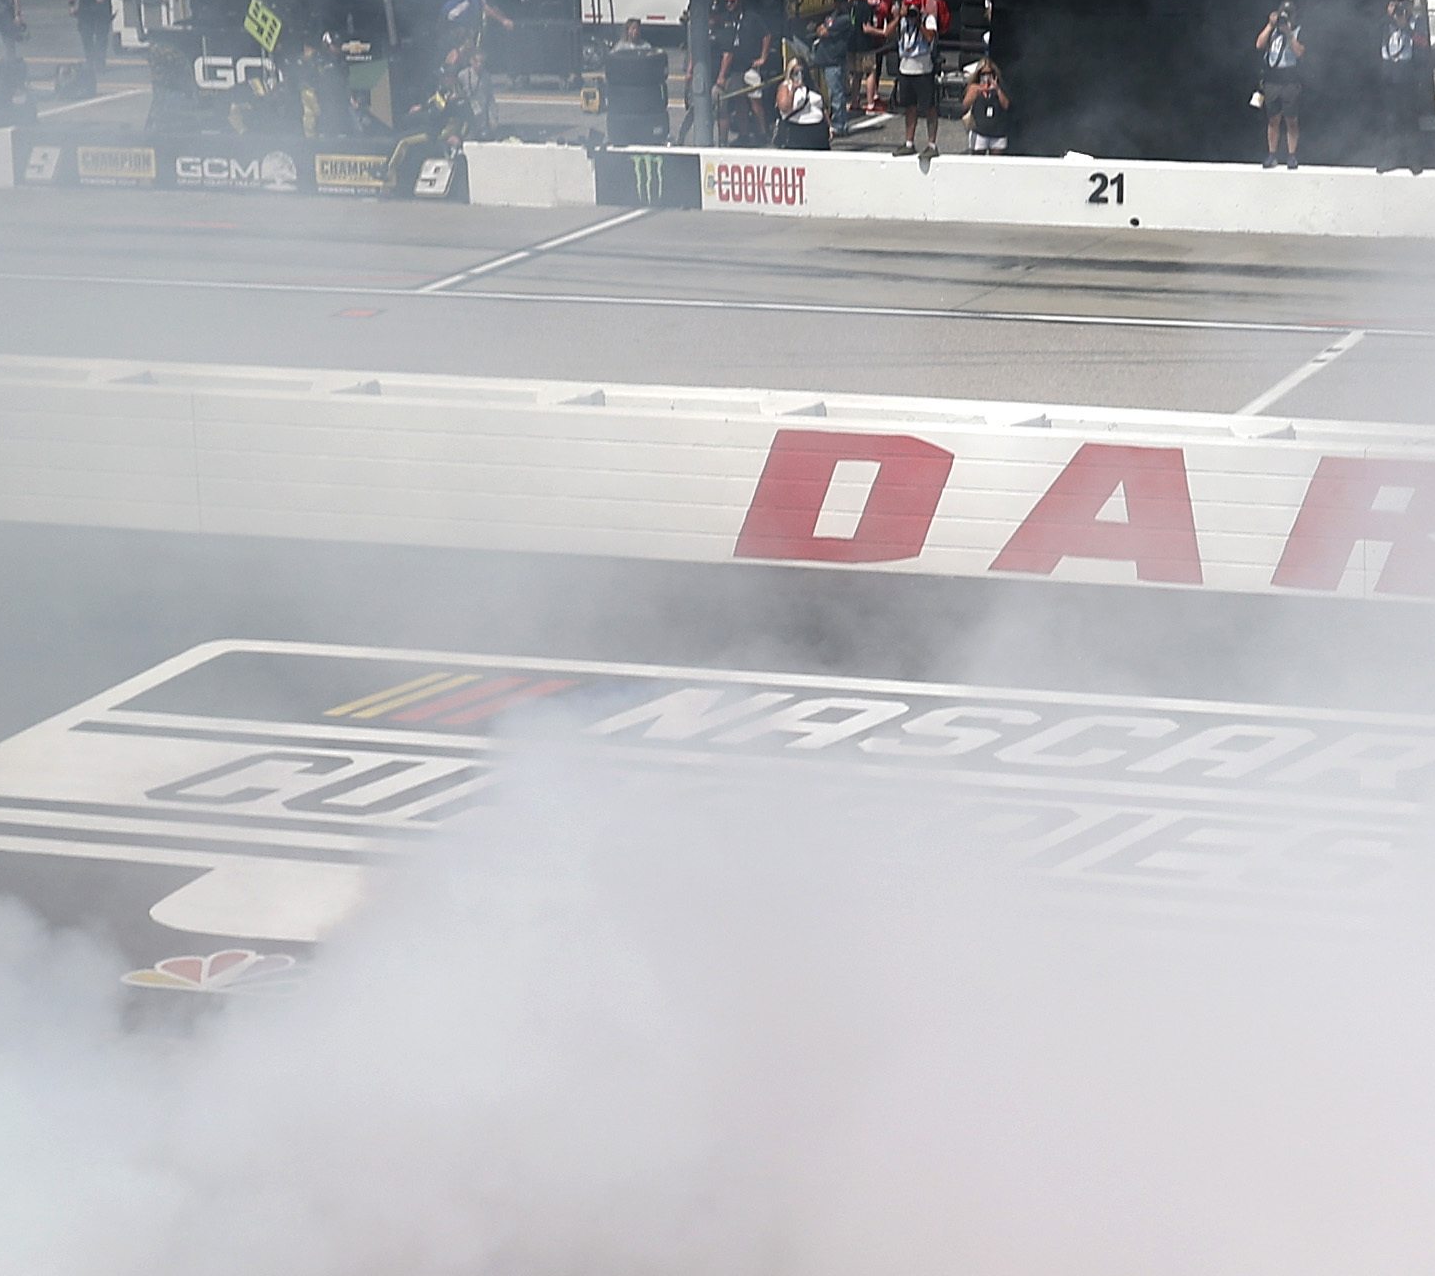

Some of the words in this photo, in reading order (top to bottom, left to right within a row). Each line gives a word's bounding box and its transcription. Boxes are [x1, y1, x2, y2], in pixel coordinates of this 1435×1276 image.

[175, 157, 260, 180] GCM
[414, 157, 455, 197] 9
[717, 164, 767, 204] COOK
[770, 166, 807, 206] OUT
[1089, 172, 1126, 206] 21
